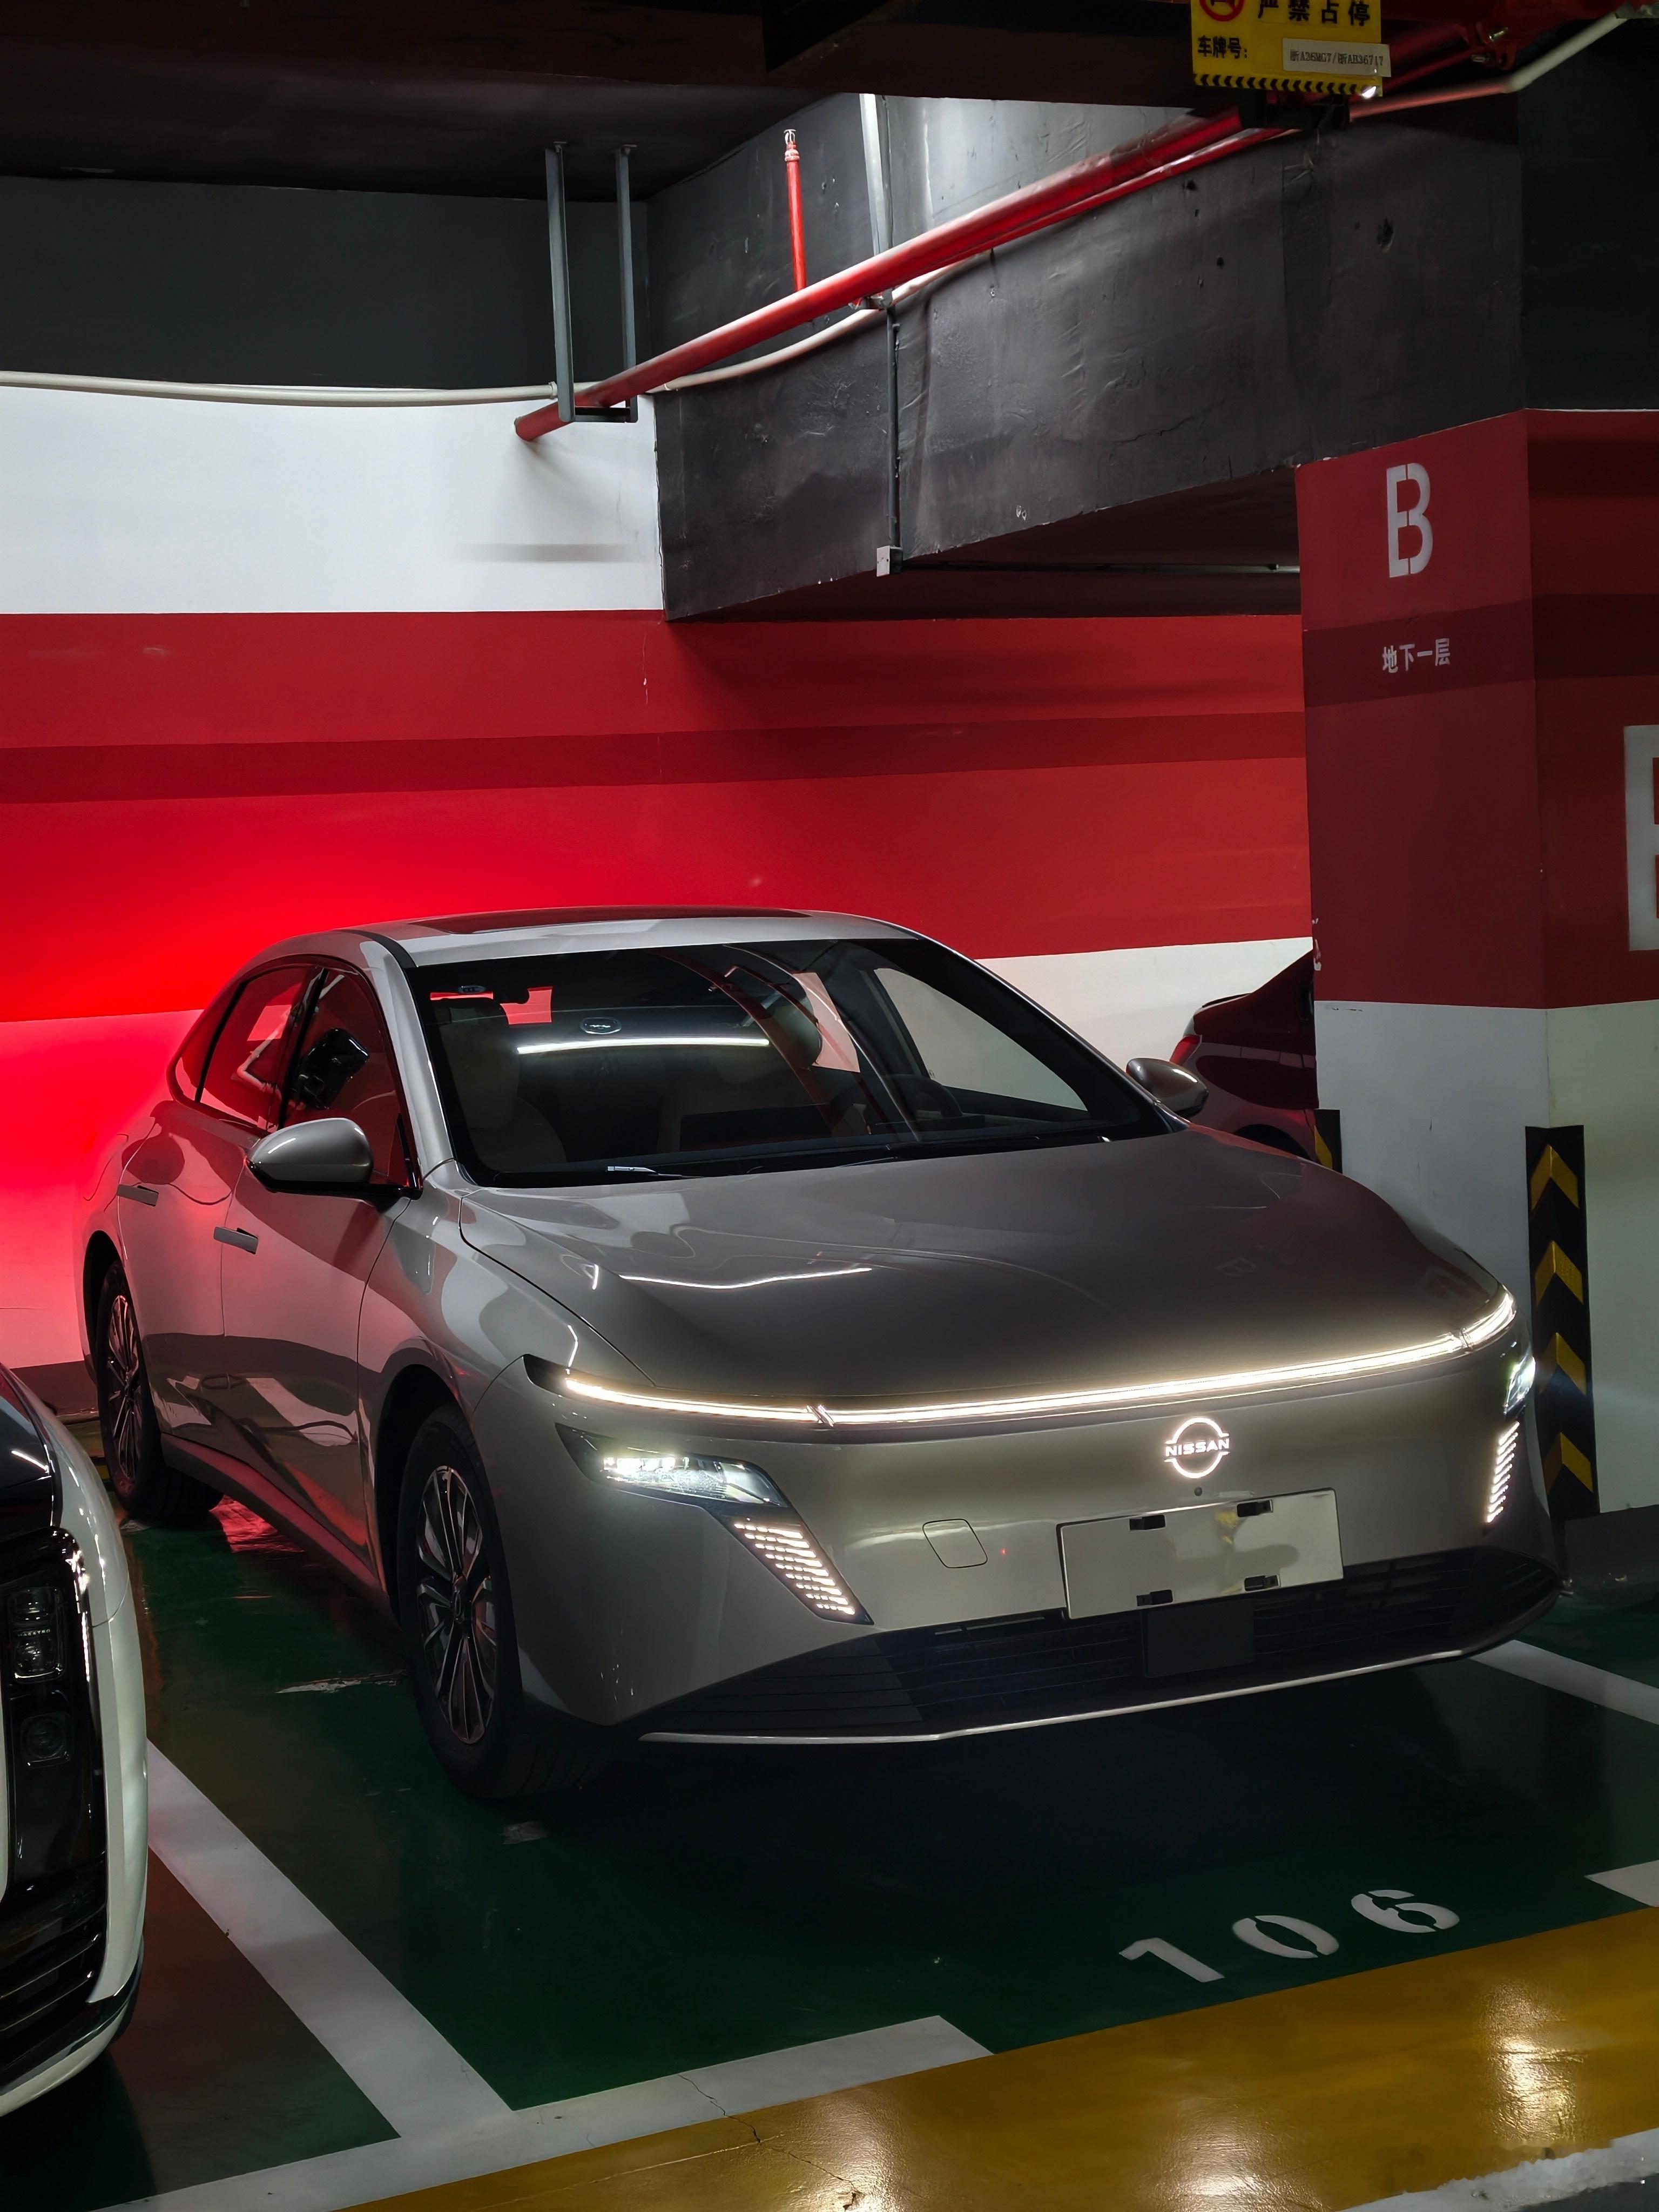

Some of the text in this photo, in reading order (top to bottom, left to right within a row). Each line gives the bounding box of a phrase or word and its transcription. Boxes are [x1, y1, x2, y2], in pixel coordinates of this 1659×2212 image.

[1258, 0, 1370, 26] 严禁占停
[1386, 463, 1433, 578] B
[1382, 638, 1451, 673] 地下一层
[1165, 1438, 1230, 1456] NISSAN
[1118, 1890, 1460, 1983] 106
